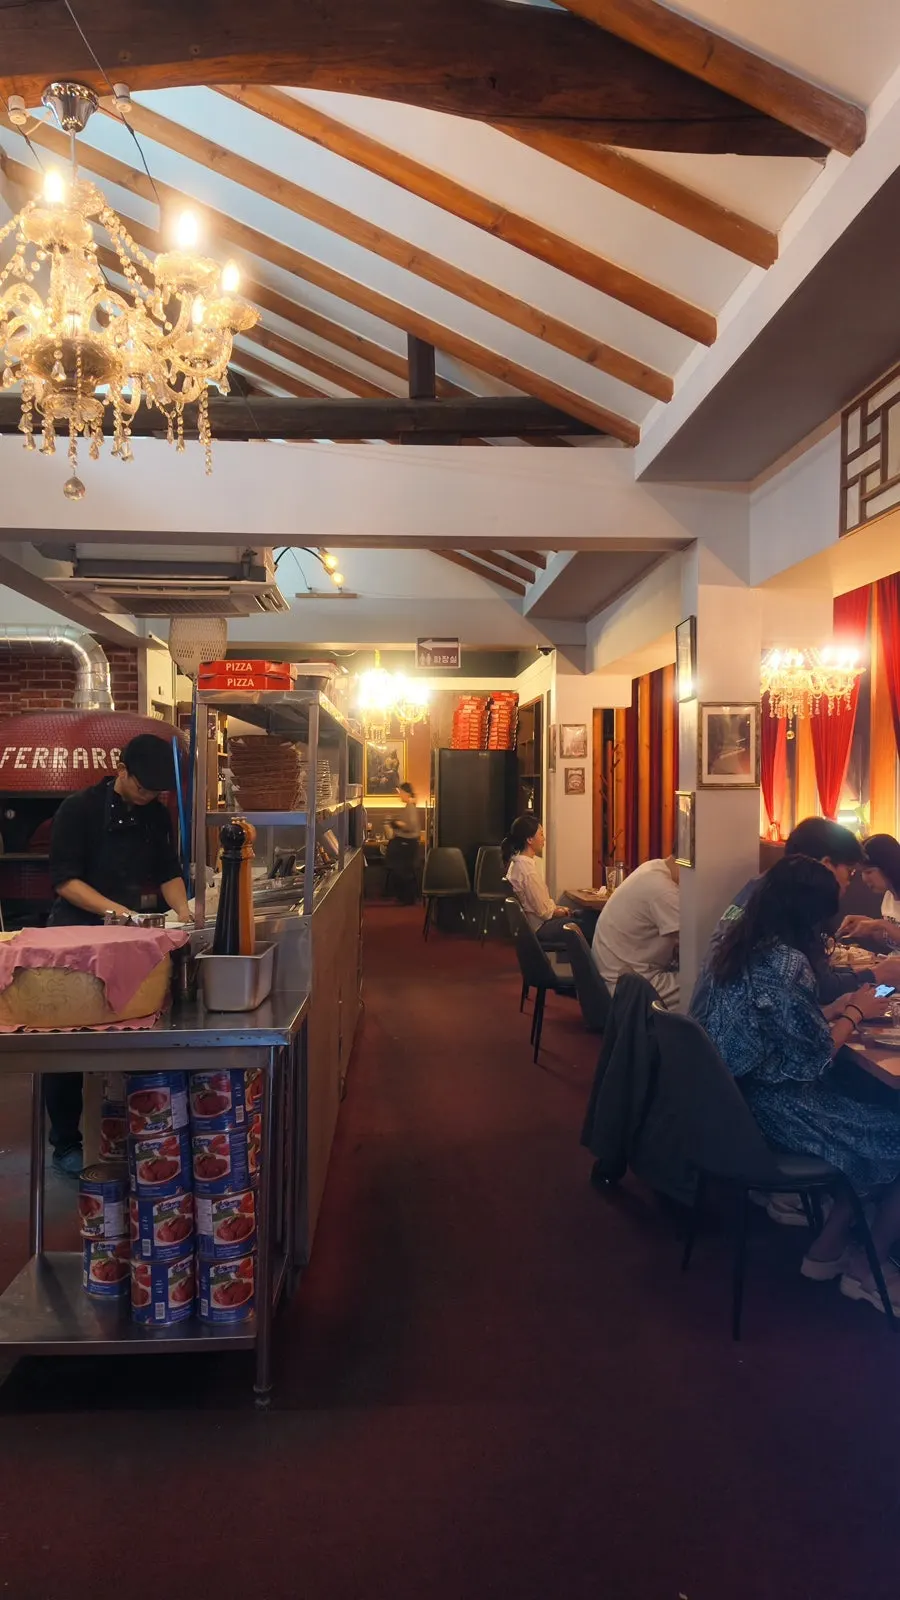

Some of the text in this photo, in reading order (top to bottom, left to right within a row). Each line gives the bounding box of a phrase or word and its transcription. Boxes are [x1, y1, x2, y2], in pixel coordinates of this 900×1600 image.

[433, 655, 457, 664] 화장실
[226, 662, 253, 671] PIZZA
[227, 678, 254, 687] PIZZA
